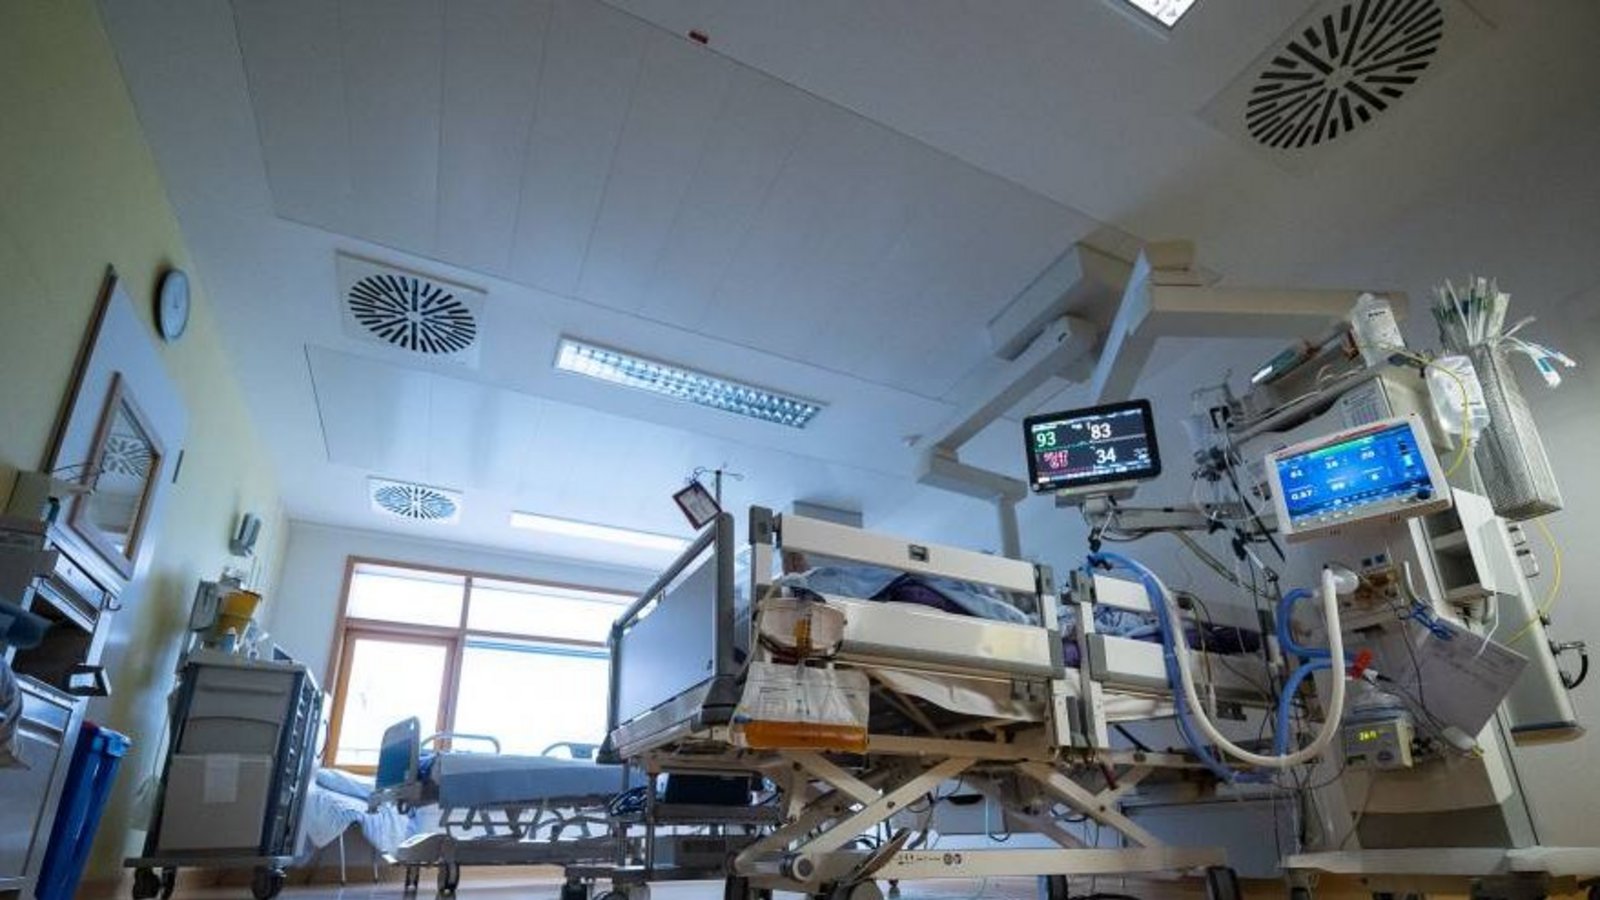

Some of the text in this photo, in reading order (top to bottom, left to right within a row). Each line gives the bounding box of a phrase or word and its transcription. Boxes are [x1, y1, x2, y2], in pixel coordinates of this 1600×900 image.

[1036, 431, 1056, 447] 93
[1091, 423, 1111, 439] 83
[1096, 448, 1115, 463] 34
